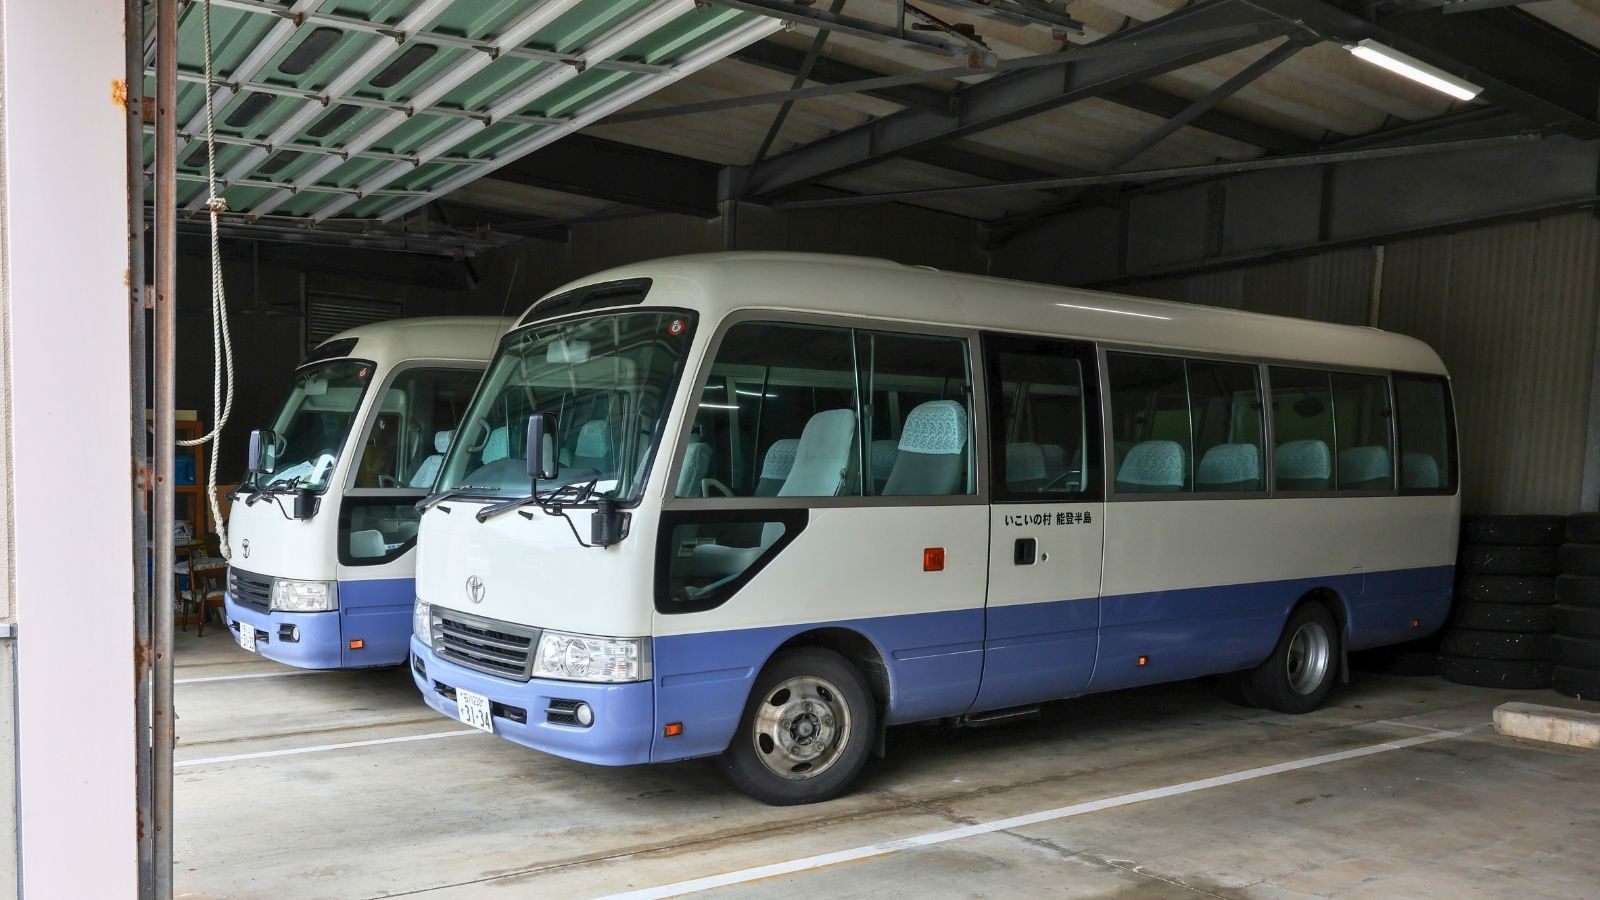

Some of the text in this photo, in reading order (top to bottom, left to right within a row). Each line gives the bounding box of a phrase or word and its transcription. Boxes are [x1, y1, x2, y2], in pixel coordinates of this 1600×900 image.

[1005, 511, 1092, 526] いこいの村 能登半島
